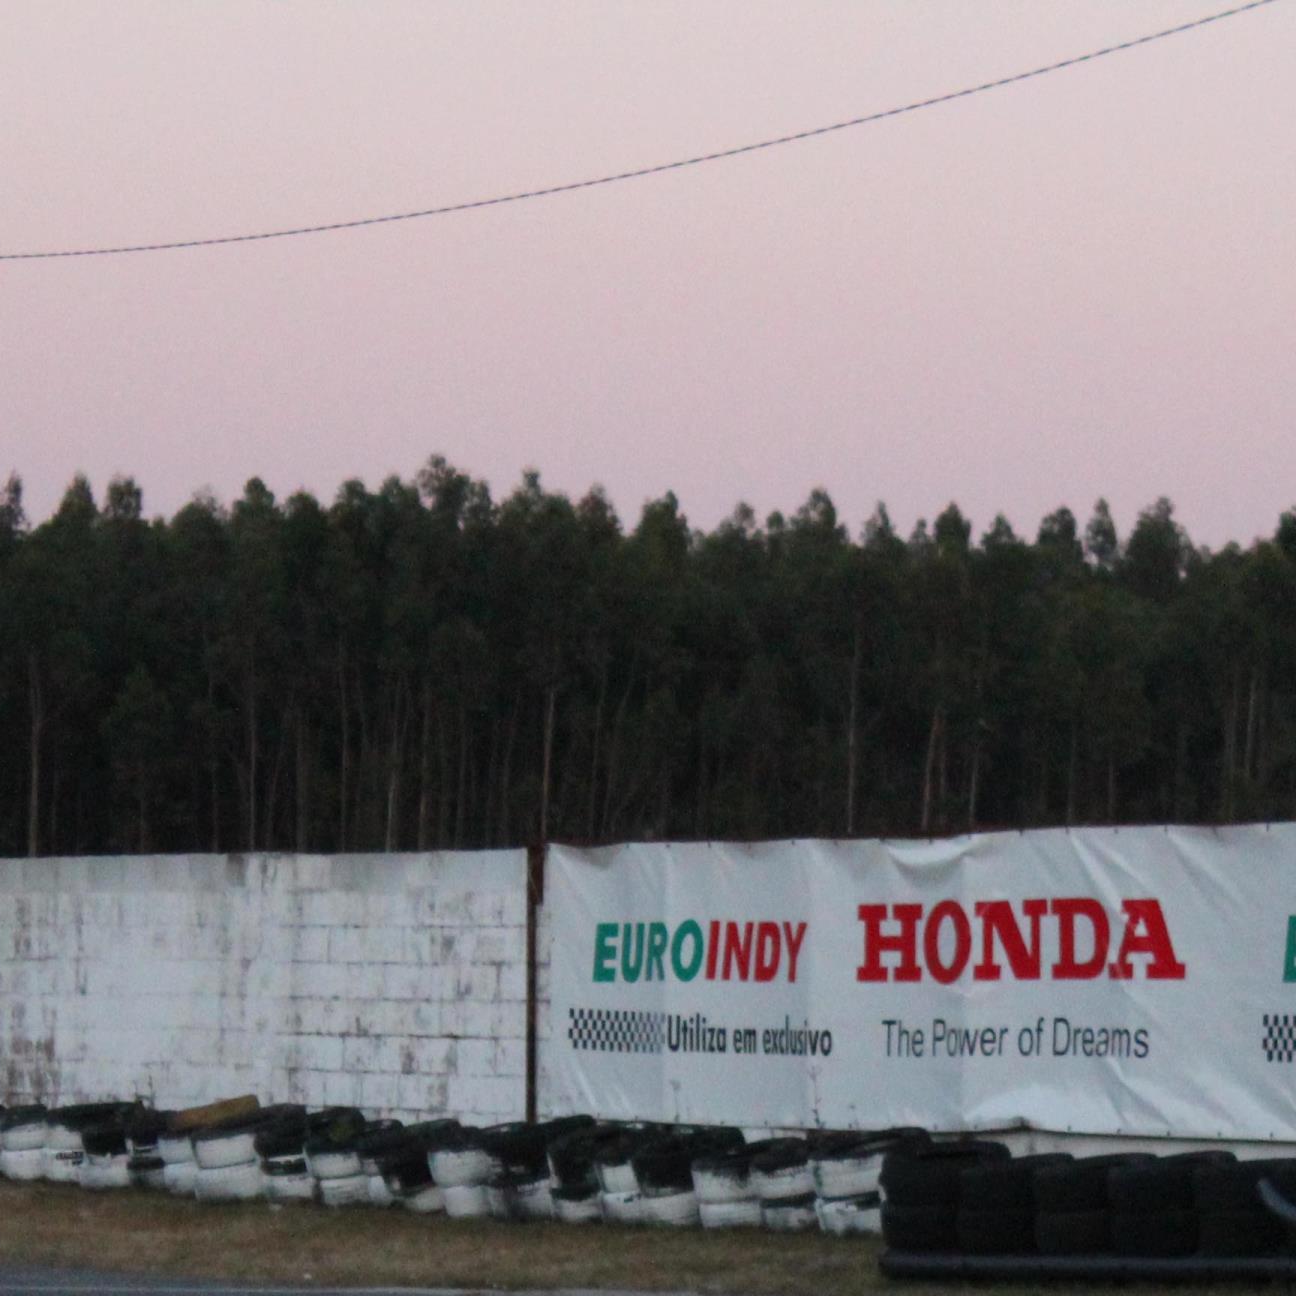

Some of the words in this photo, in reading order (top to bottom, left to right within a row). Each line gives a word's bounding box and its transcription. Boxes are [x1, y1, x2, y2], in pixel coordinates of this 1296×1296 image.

[592, 918, 808, 983] EUROINDY
[856, 897, 1186, 985] HONDA
[666, 1012, 727, 1053] Utiliza
[732, 1027, 757, 1054] em
[761, 1014, 833, 1057] exclusivo
[881, 1018, 925, 1058] The
[931, 1017, 1009, 1058] Power
[1017, 1016, 1045, 1057] of
[1052, 1016, 1151, 1059] Dreams
